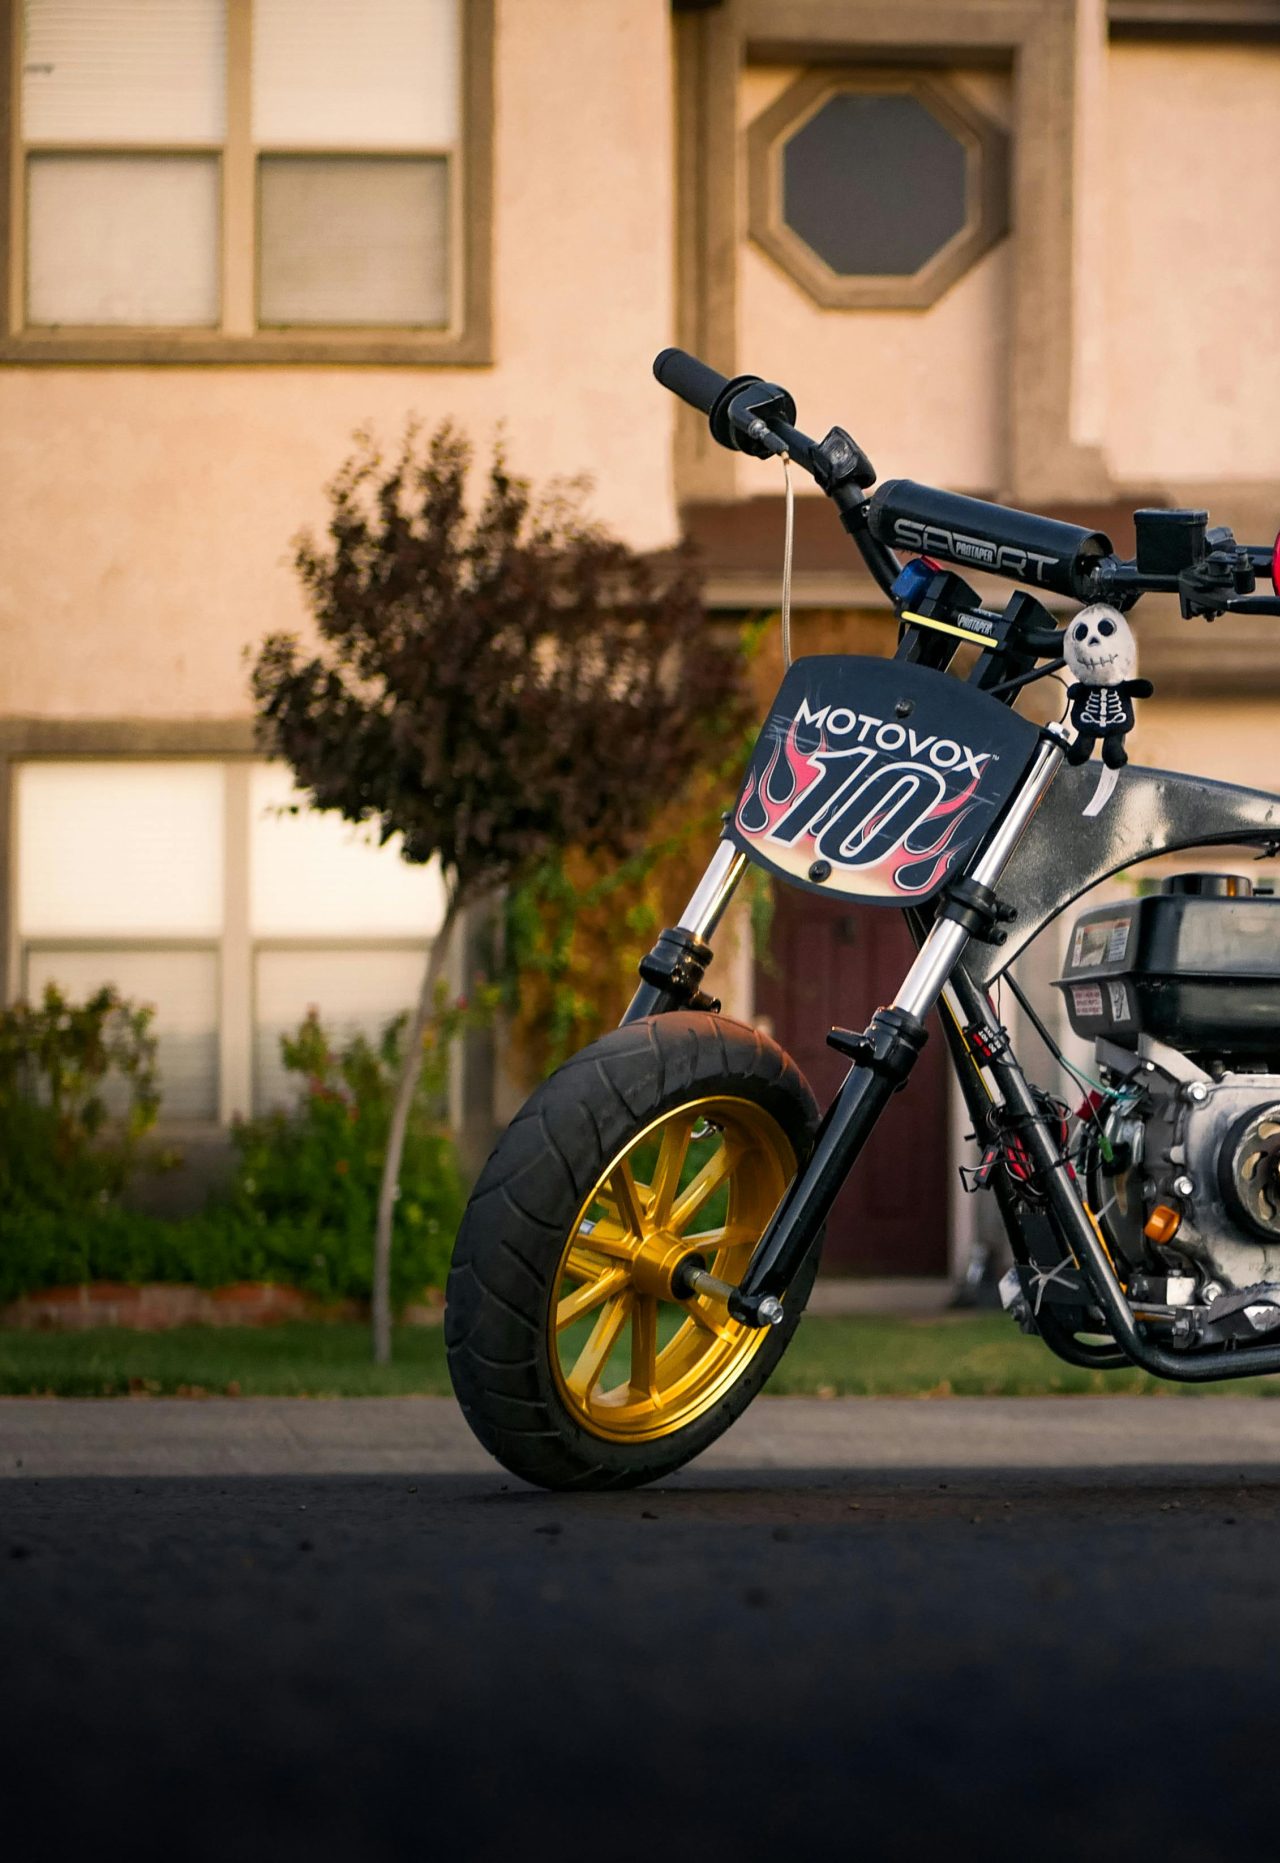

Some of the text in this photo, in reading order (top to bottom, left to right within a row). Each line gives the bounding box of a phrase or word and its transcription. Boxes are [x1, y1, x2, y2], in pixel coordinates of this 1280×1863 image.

[956, 541, 993, 563] PROTAPER
[794, 697, 991, 780] MOTOVOX
[764, 746, 946, 870] 10
